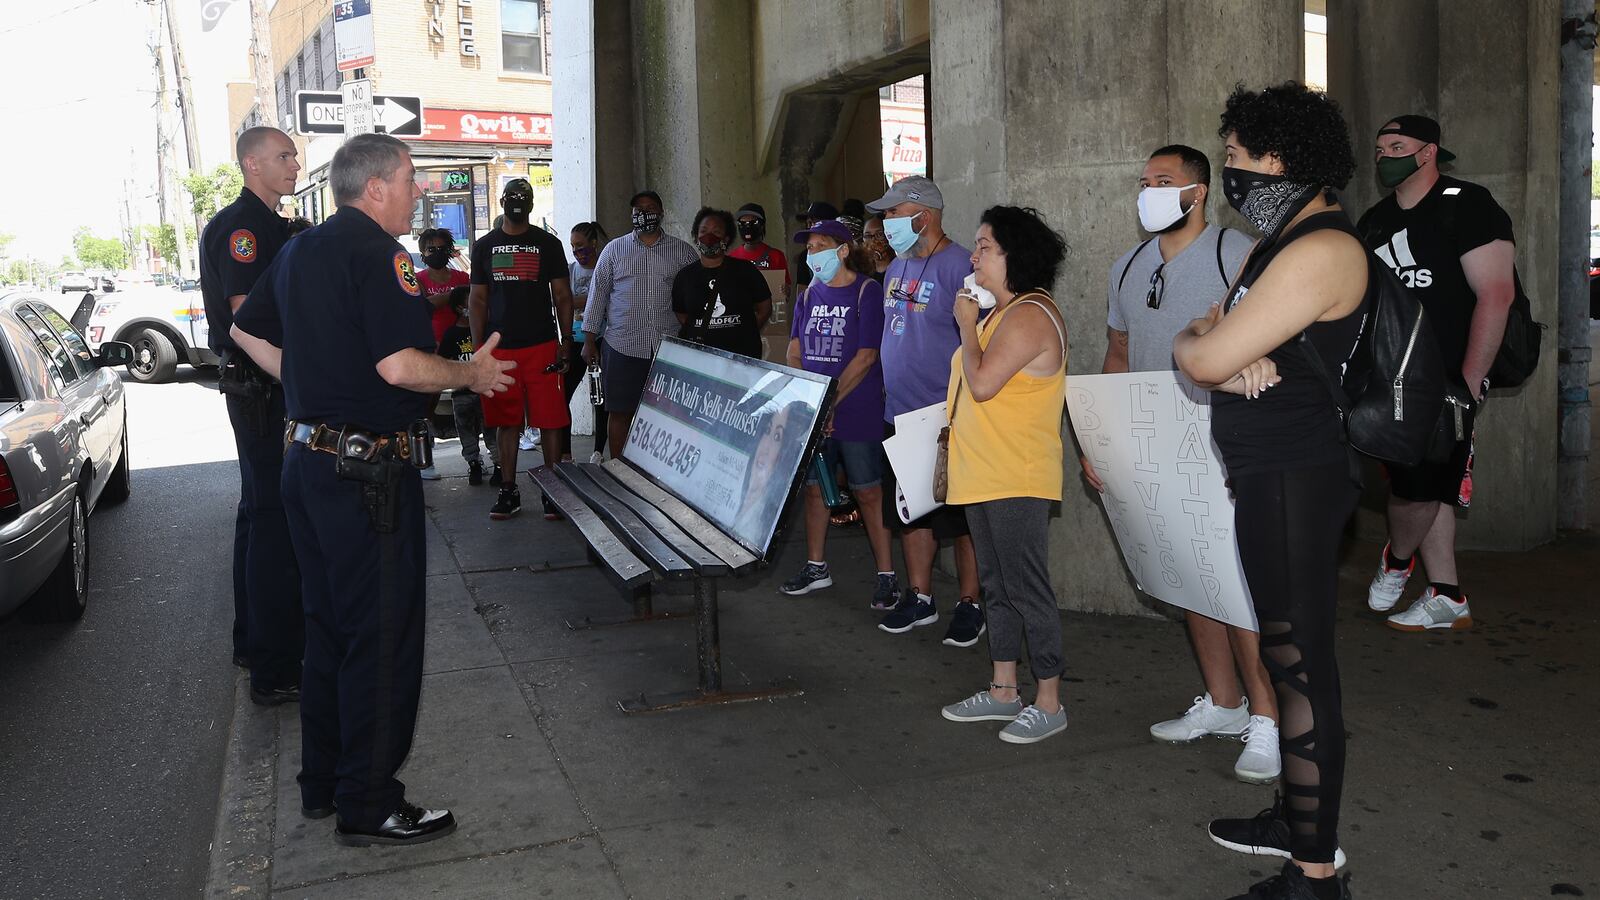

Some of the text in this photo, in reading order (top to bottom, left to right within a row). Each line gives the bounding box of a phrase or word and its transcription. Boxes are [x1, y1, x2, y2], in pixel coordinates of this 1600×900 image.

[352, 87, 363, 101] NO
[312, 106, 344, 122] ONE
[345, 101, 371, 114] STOPPING
[354, 115, 365, 125] BUS
[460, 113, 525, 134] Qwik
[352, 126, 368, 135] STOP
[892, 146, 922, 162] Pizza
[445, 173, 469, 185] ATM
[491, 245, 540, 254] FREE-ish
[810, 304, 851, 318] RELAY
[804, 336, 844, 357] LIFE
[649, 373, 762, 437] Ally McNally Sells Houses!
[1129, 383, 1183, 589] LIVES
[1173, 383, 1229, 619] MATTER
